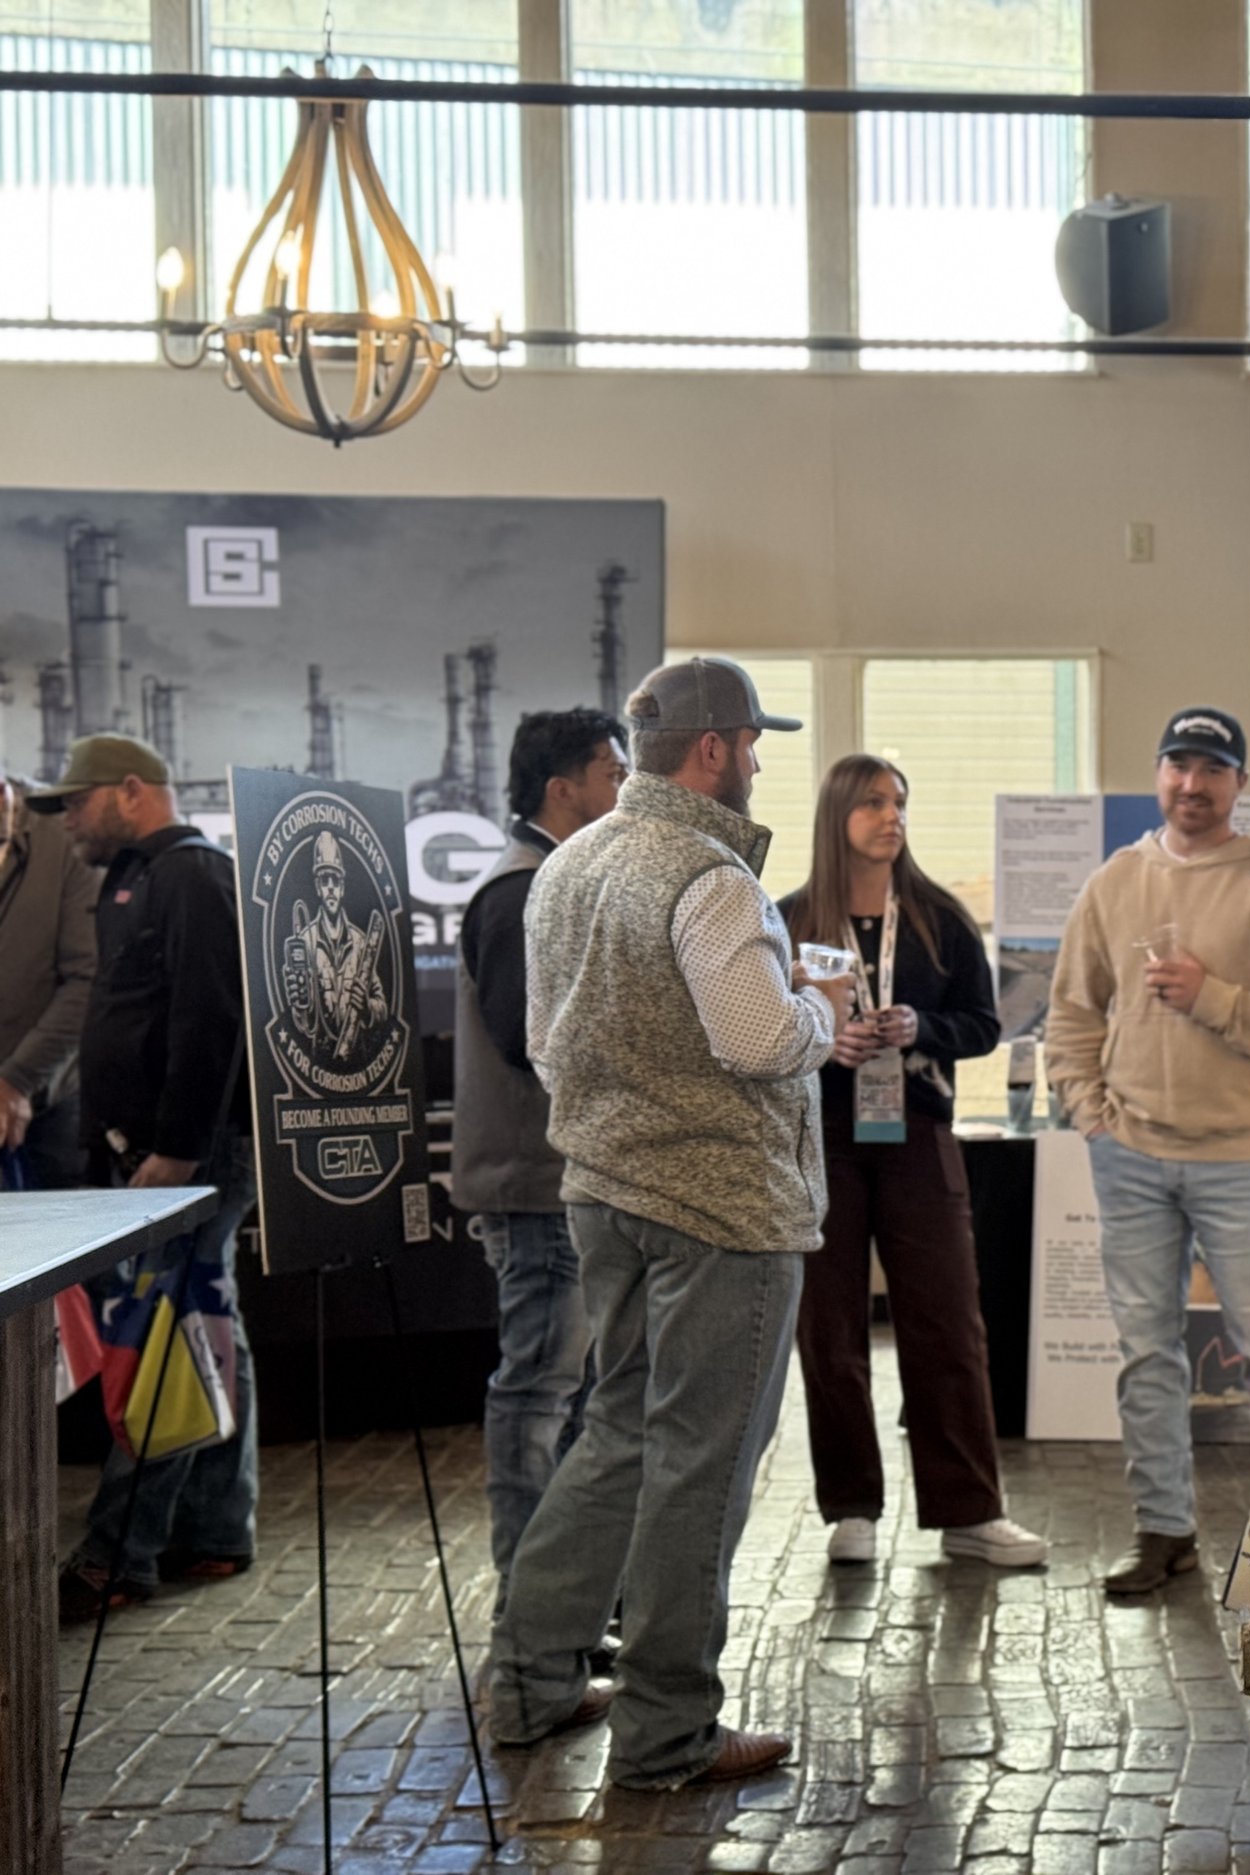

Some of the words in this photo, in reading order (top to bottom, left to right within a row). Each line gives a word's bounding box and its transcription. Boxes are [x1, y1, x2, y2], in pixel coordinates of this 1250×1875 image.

[267, 832, 284, 866] BY
[282, 804, 347, 841] CORROSION
[348, 816, 384, 874] TECHS
[287, 1040, 310, 1077] FOR
[312, 1065, 367, 1092] CORROSION
[367, 1040, 394, 1082] TECHS
[282, 1109, 322, 1130] BECOME
[323, 1110, 331, 1127] A
[331, 1106, 375, 1127] FOUNDING
[375, 1104, 408, 1123] MEMBER
[318, 1135, 383, 1179] CTA
